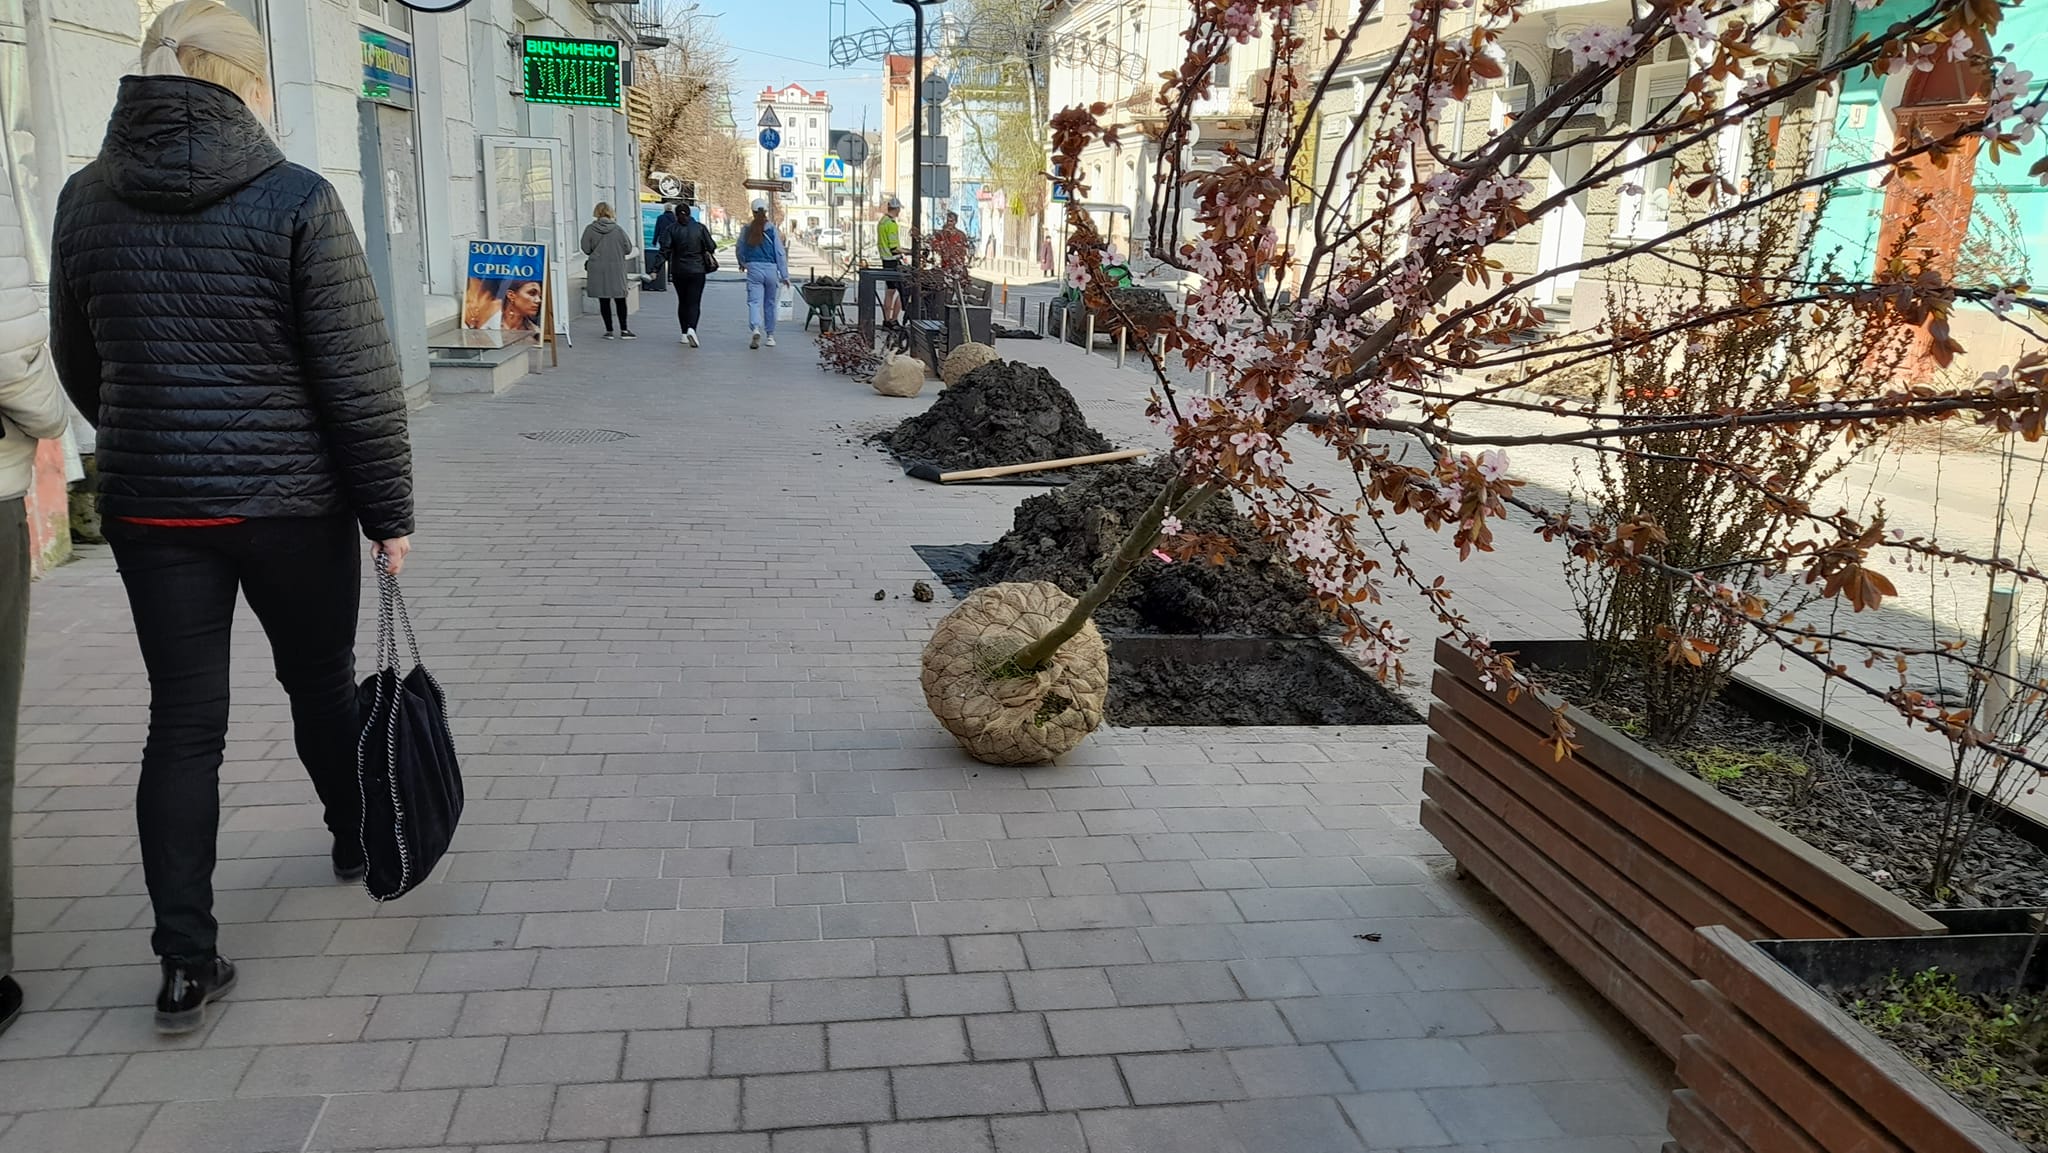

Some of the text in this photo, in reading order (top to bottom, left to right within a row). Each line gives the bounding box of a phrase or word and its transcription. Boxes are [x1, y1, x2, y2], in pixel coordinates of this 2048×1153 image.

[526, 39, 616, 58] ВІДЧИНЕНО
[1854, 107, 1861, 124] 9
[783, 165, 791, 177] P
[471, 242, 538, 257] ЗОЛОТО
[473, 262, 534, 277] СРІБЛО
